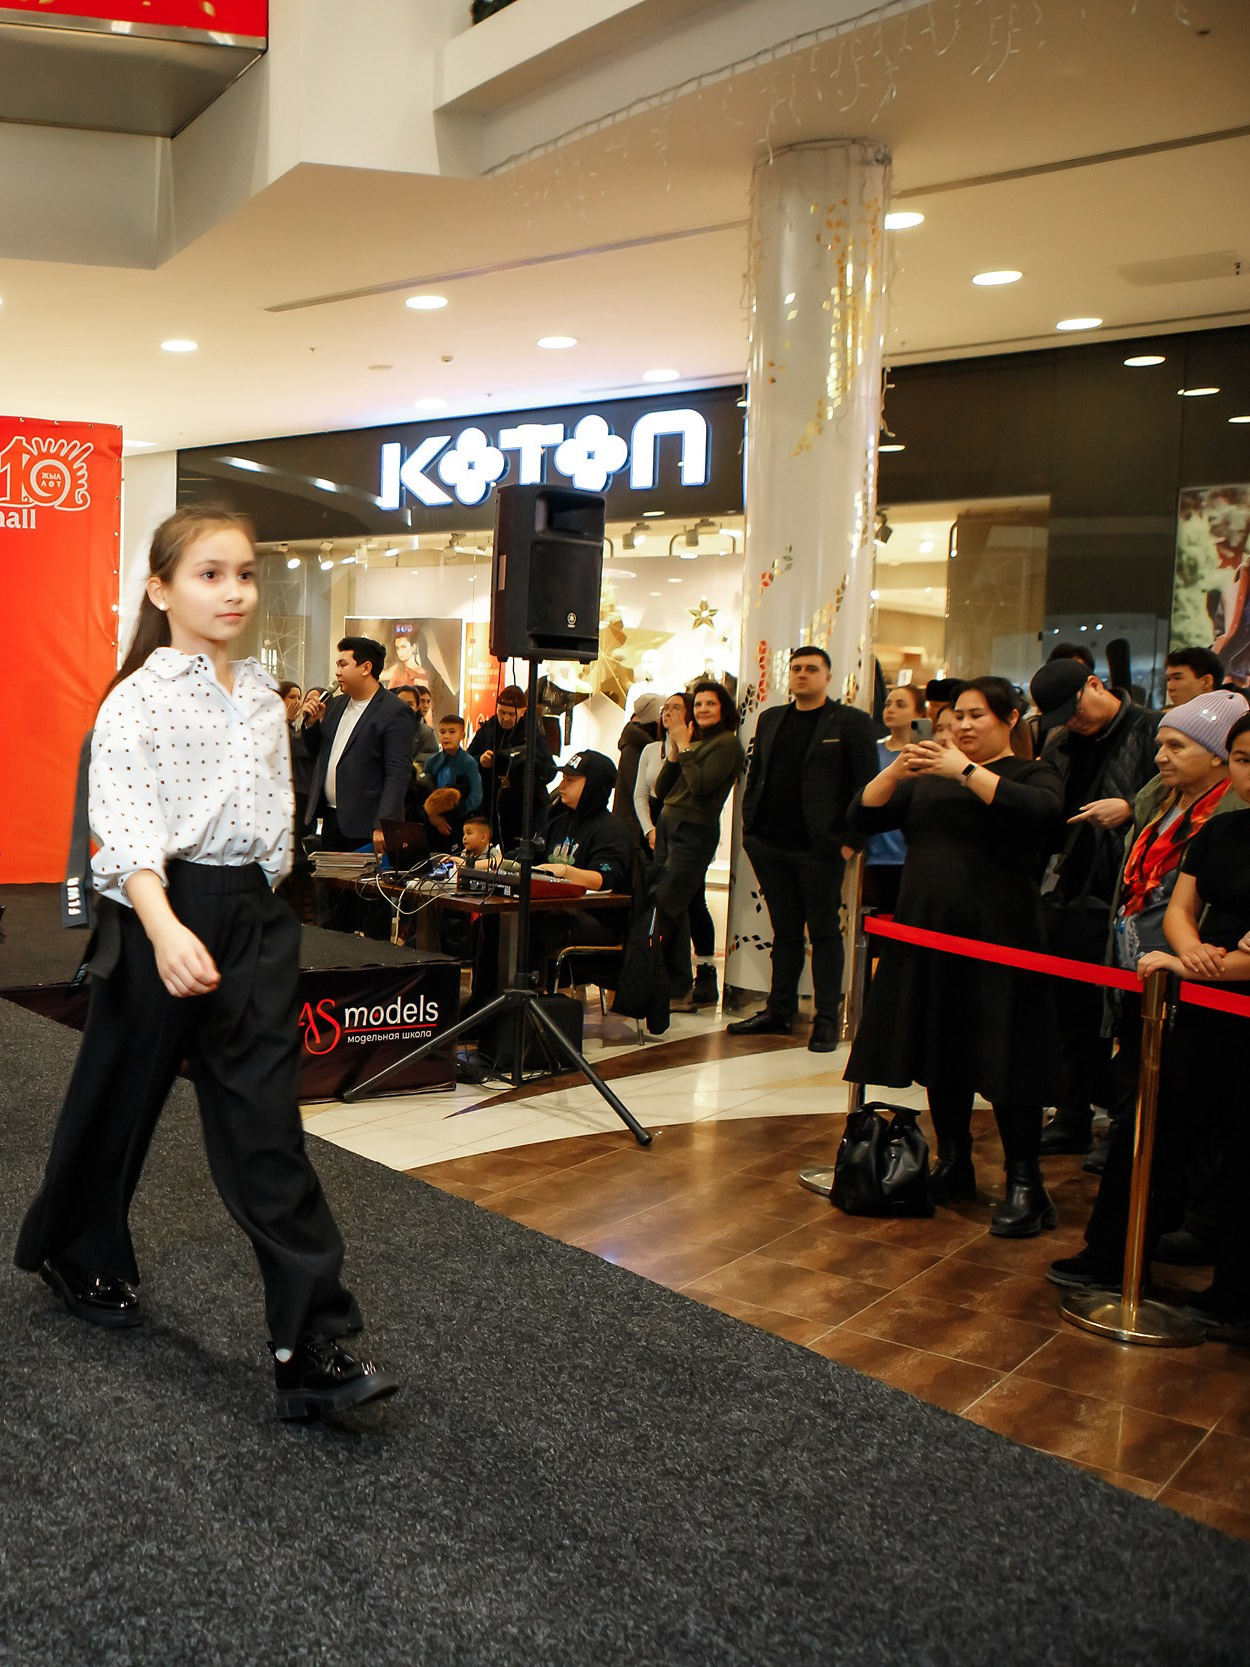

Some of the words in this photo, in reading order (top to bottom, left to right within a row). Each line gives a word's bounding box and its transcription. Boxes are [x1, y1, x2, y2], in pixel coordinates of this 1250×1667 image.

[298, 998, 340, 1055] AS
[344, 995, 438, 1027] models
[348, 1033, 399, 1044] модельная
[402, 1031, 431, 1039] школа
